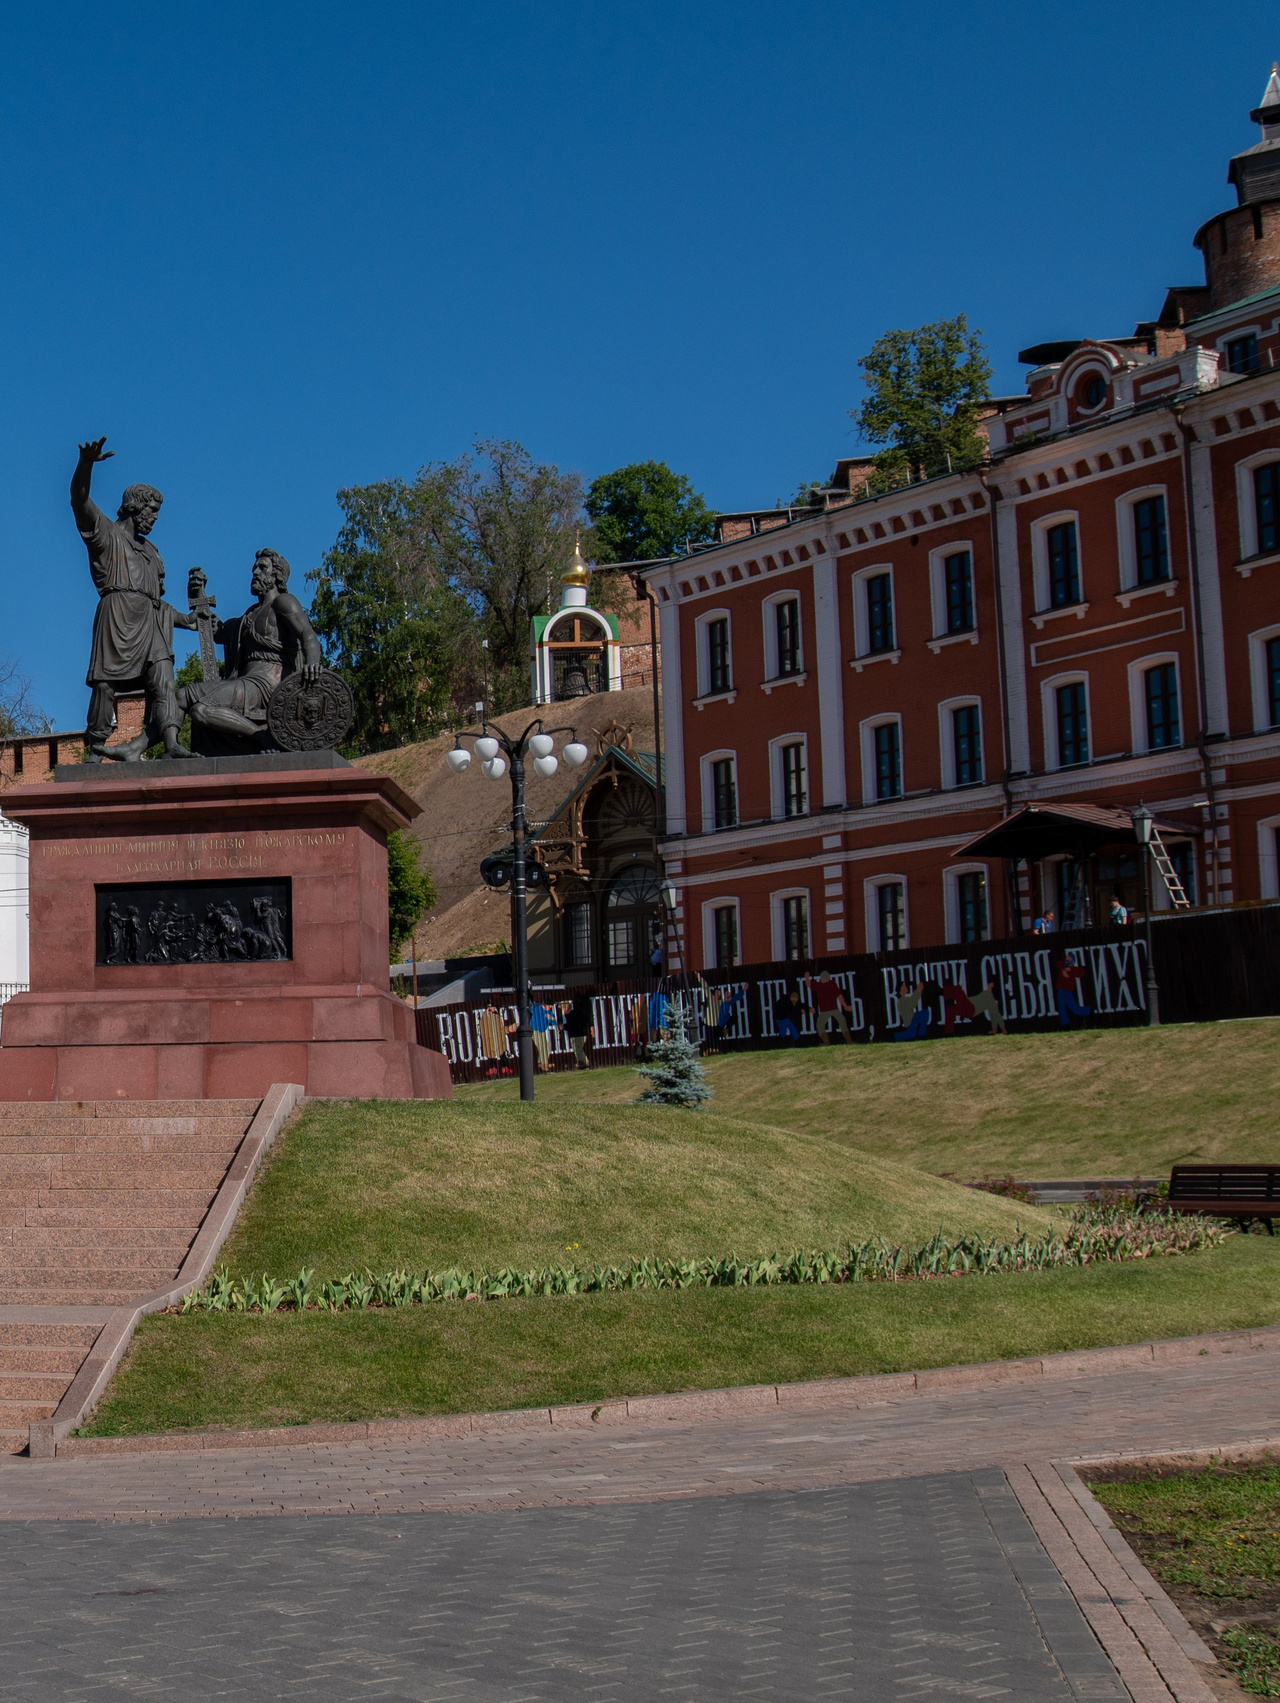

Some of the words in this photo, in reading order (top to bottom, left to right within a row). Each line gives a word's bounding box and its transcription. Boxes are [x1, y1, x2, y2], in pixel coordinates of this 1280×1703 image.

[187, 839, 196, 851] И
[201, 838, 245, 850] КНЯЗЮ
[255, 834, 345, 848] ПОЖАРСКОМУ
[116, 860, 201, 873] БЛАГОДАРНАЯ
[980, 949, 1060, 1021] СЕБЯ
